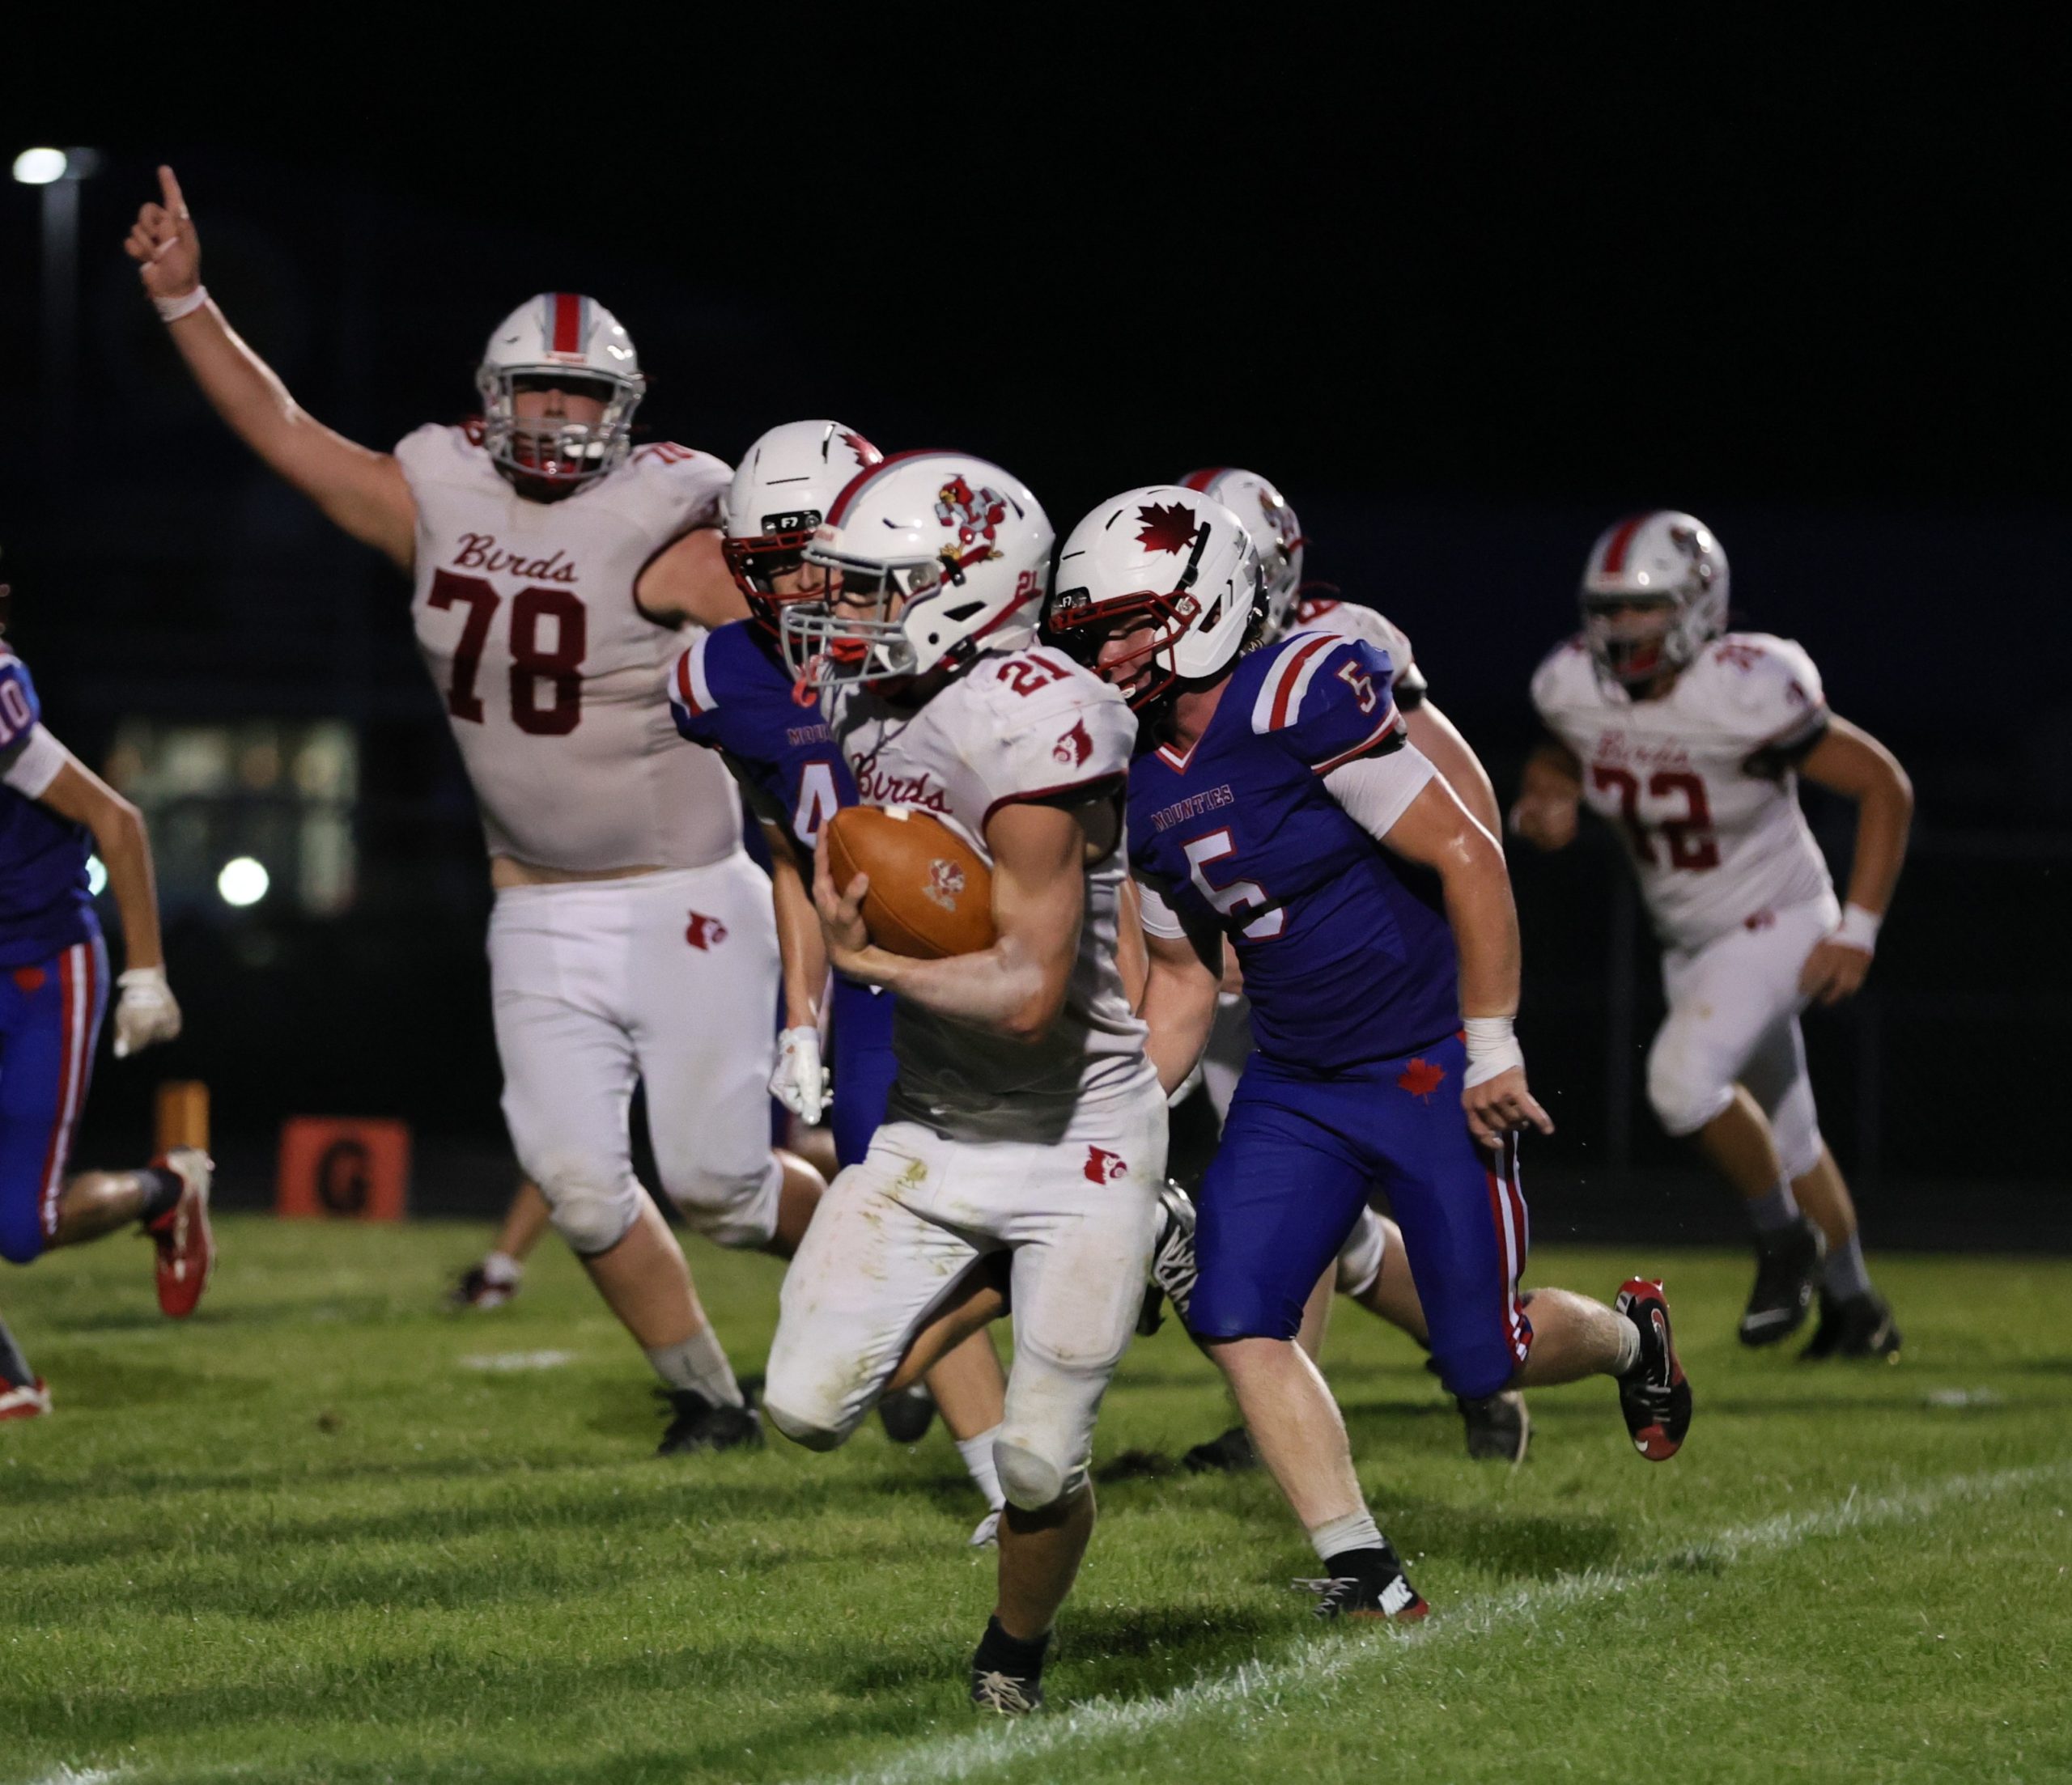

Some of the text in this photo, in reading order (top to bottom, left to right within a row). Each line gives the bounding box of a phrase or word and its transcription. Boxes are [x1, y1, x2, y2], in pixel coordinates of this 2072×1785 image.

[781, 516, 798, 528] F7
[453, 532, 578, 582] Birds
[1014, 570, 1038, 600] 21
[1063, 596, 1072, 608] F7
[427, 568, 587, 735] 78
[996, 654, 1074, 697] 21
[1335, 657, 1378, 715] 5
[792, 760, 839, 850] 4
[851, 752, 953, 814] Birds
[1151, 784, 1234, 833] MOUNTIES
[1592, 765, 1721, 872] 72
[1180, 826, 1288, 943] 5
[317, 1137, 372, 1215] G
